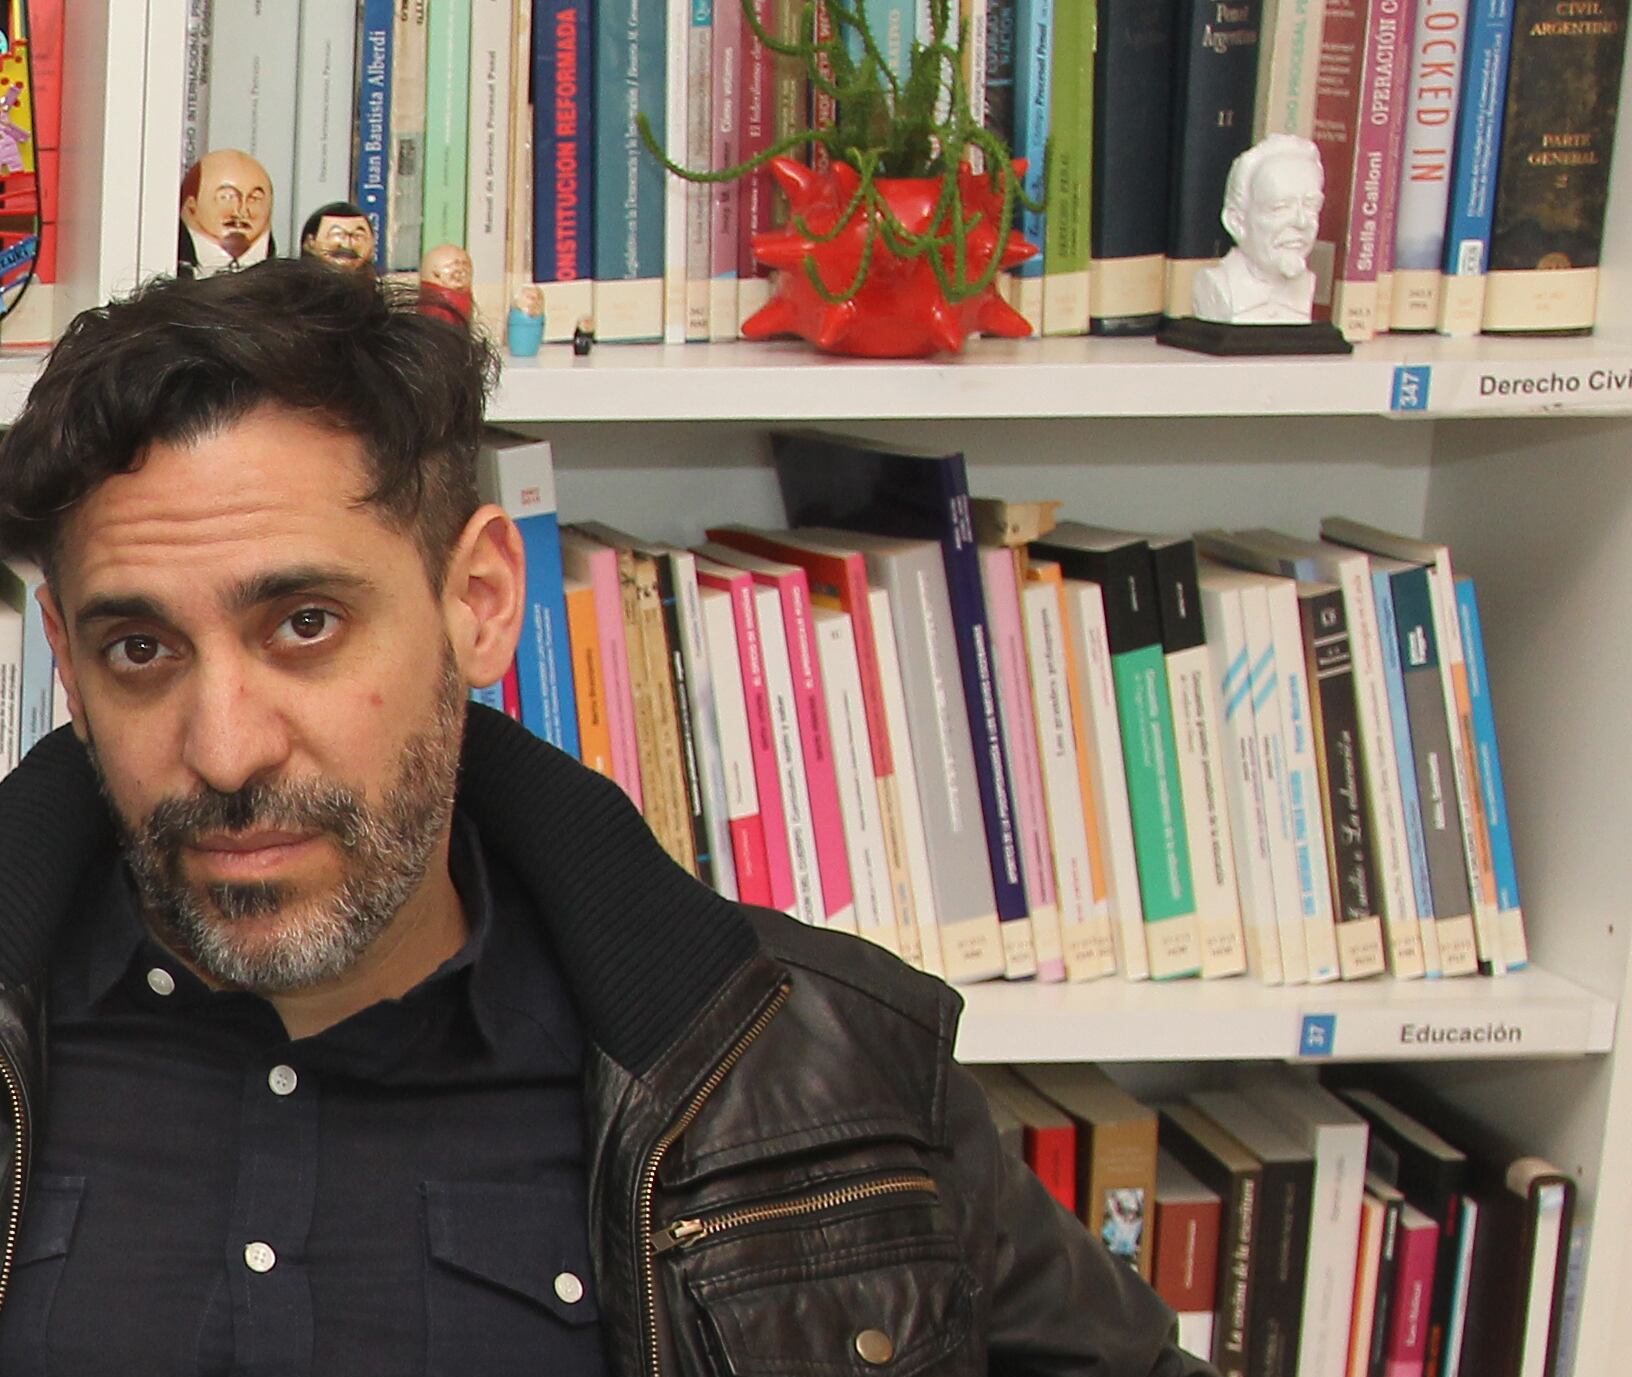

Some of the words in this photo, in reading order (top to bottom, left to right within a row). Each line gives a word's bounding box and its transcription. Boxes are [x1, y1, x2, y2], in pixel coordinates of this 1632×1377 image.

[186, 21, 200, 121] INTERNACIONAL
[370, 30, 388, 84] Alberdi
[554, 7, 580, 136] REFORMADA
[1362, 17, 1401, 125] OPERACIÓN
[368, 87, 386, 151] Bautista
[366, 154, 383, 189] Juan
[1362, 150, 1388, 216] Calloni
[1411, 149, 1445, 184] IN
[551, 141, 578, 281] ONSTITUCION
[1355, 219, 1379, 271] Stella
[1399, 369, 1421, 408] 347
[1479, 372, 1581, 396] Derecho
[1400, 1022, 1523, 1044] Educación
